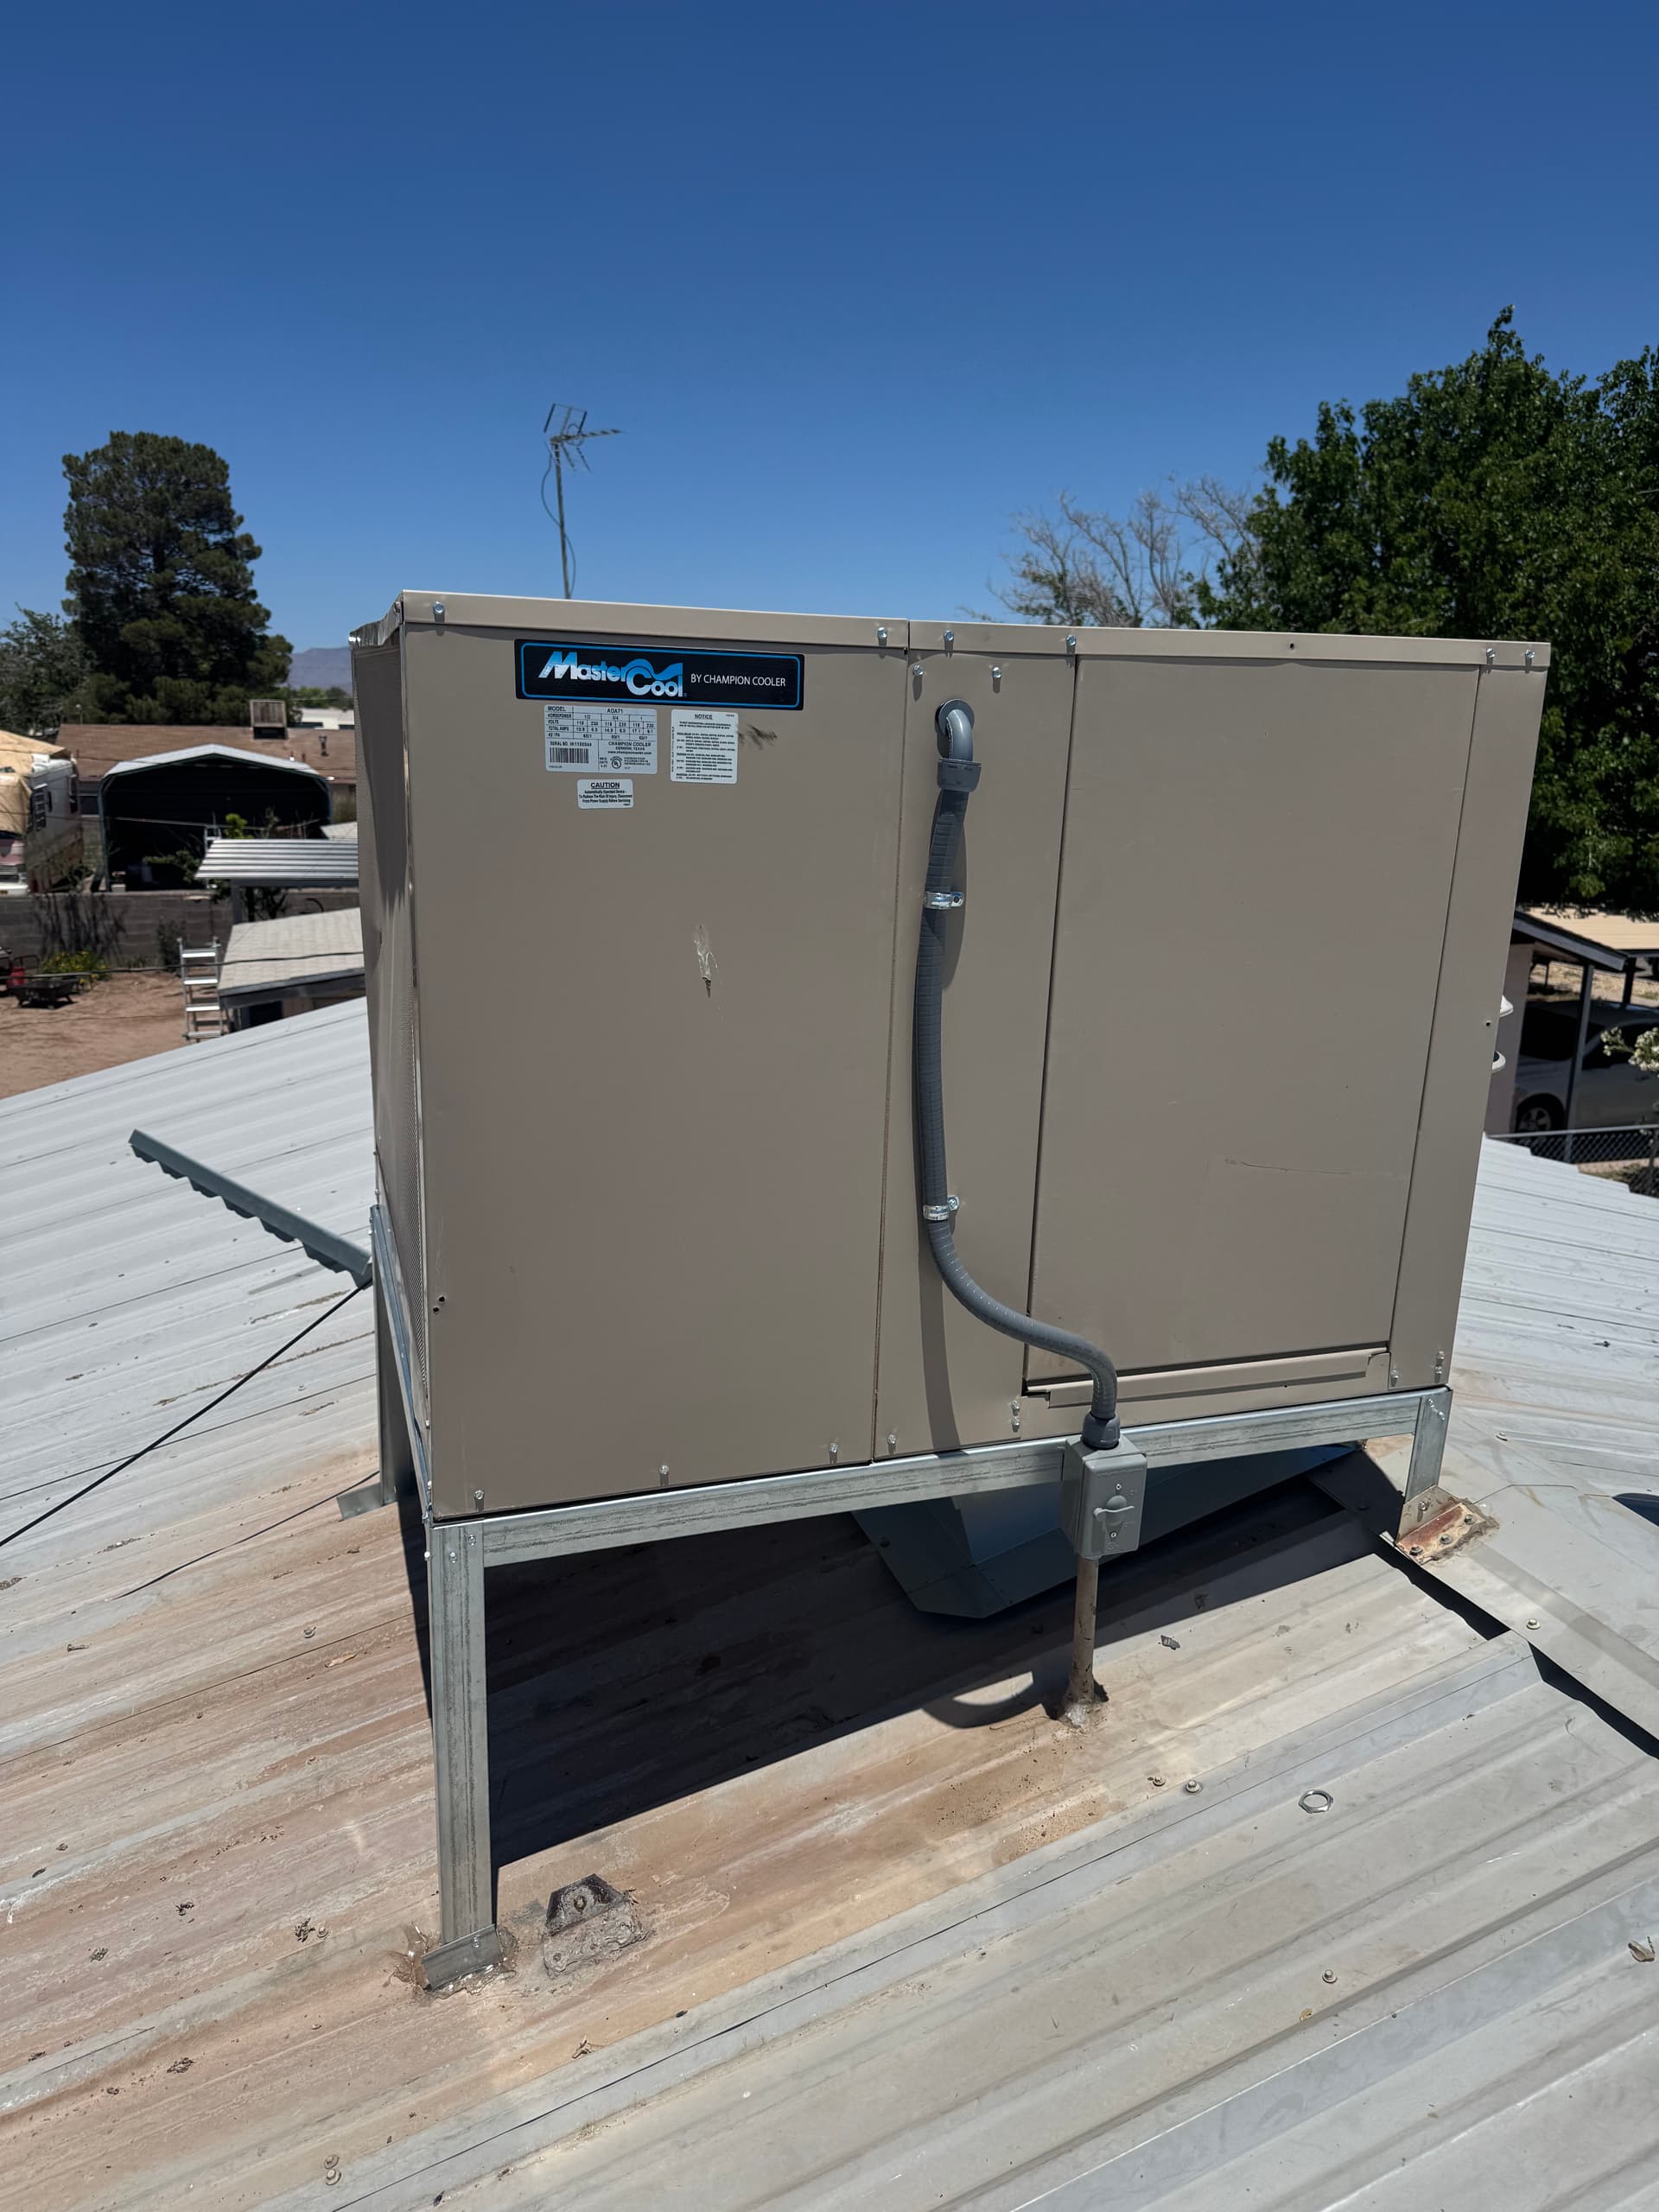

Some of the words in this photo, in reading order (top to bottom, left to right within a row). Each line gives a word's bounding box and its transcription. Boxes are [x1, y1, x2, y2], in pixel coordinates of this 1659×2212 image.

[690, 673, 702, 683] BY
[703, 674, 751, 685] CHAMPION
[752, 676, 786, 687] COOLER
